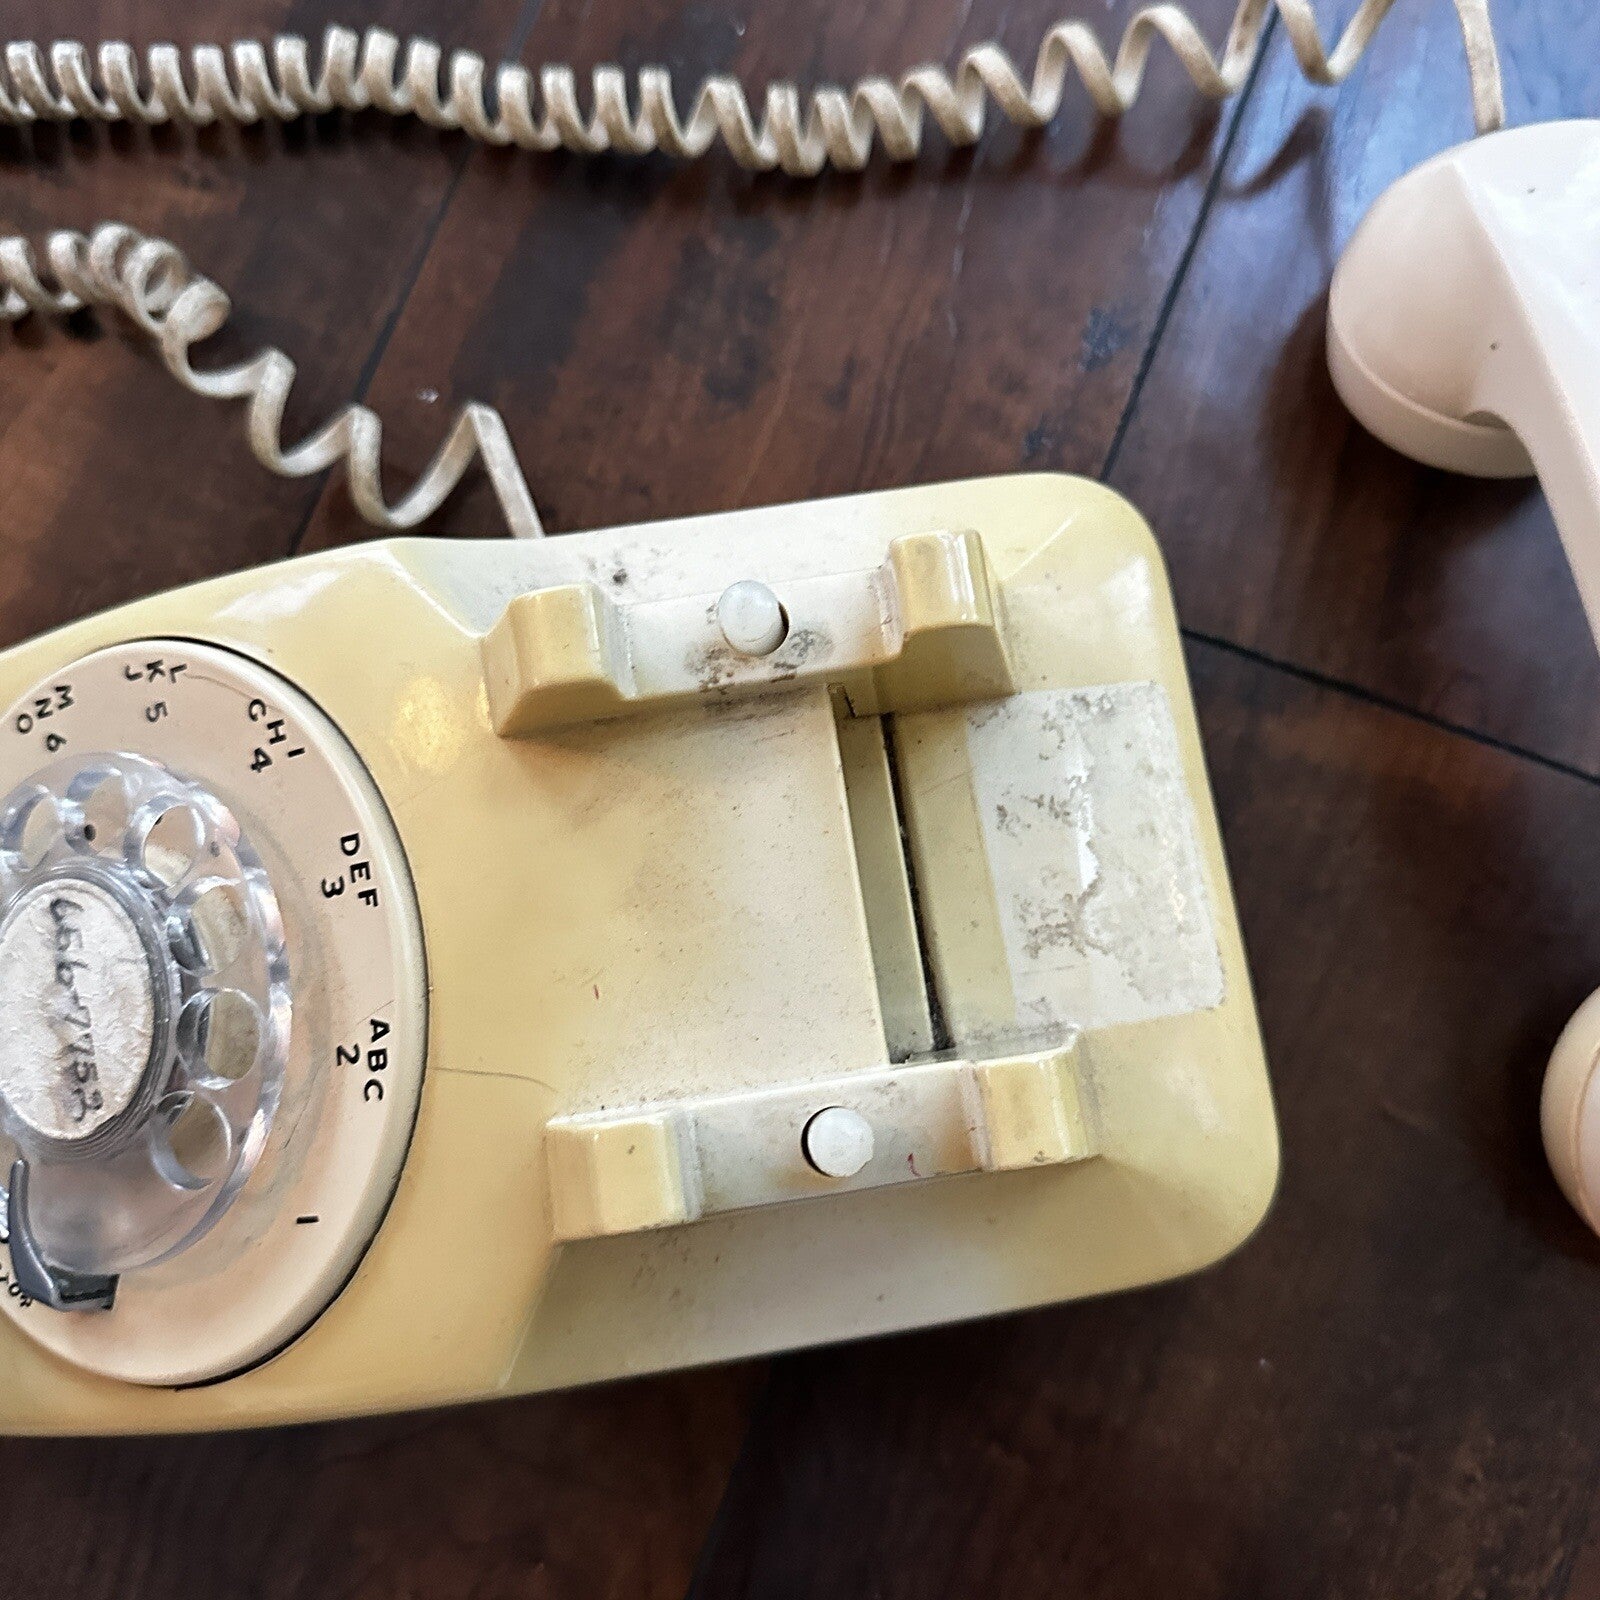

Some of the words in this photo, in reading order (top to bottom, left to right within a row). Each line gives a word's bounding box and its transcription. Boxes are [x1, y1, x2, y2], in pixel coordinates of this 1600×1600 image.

[124, 659, 188, 684] JKL
[15, 684, 75, 735] MNO
[145, 701, 168, 723] 5
[45, 733, 67, 753] 6
[249, 747, 273, 774] 4
[339, 832, 380, 908] DEF
[320, 875, 345, 899] 3
[335, 1043, 361, 1067] 2
[363, 1018, 391, 1102] ABC
